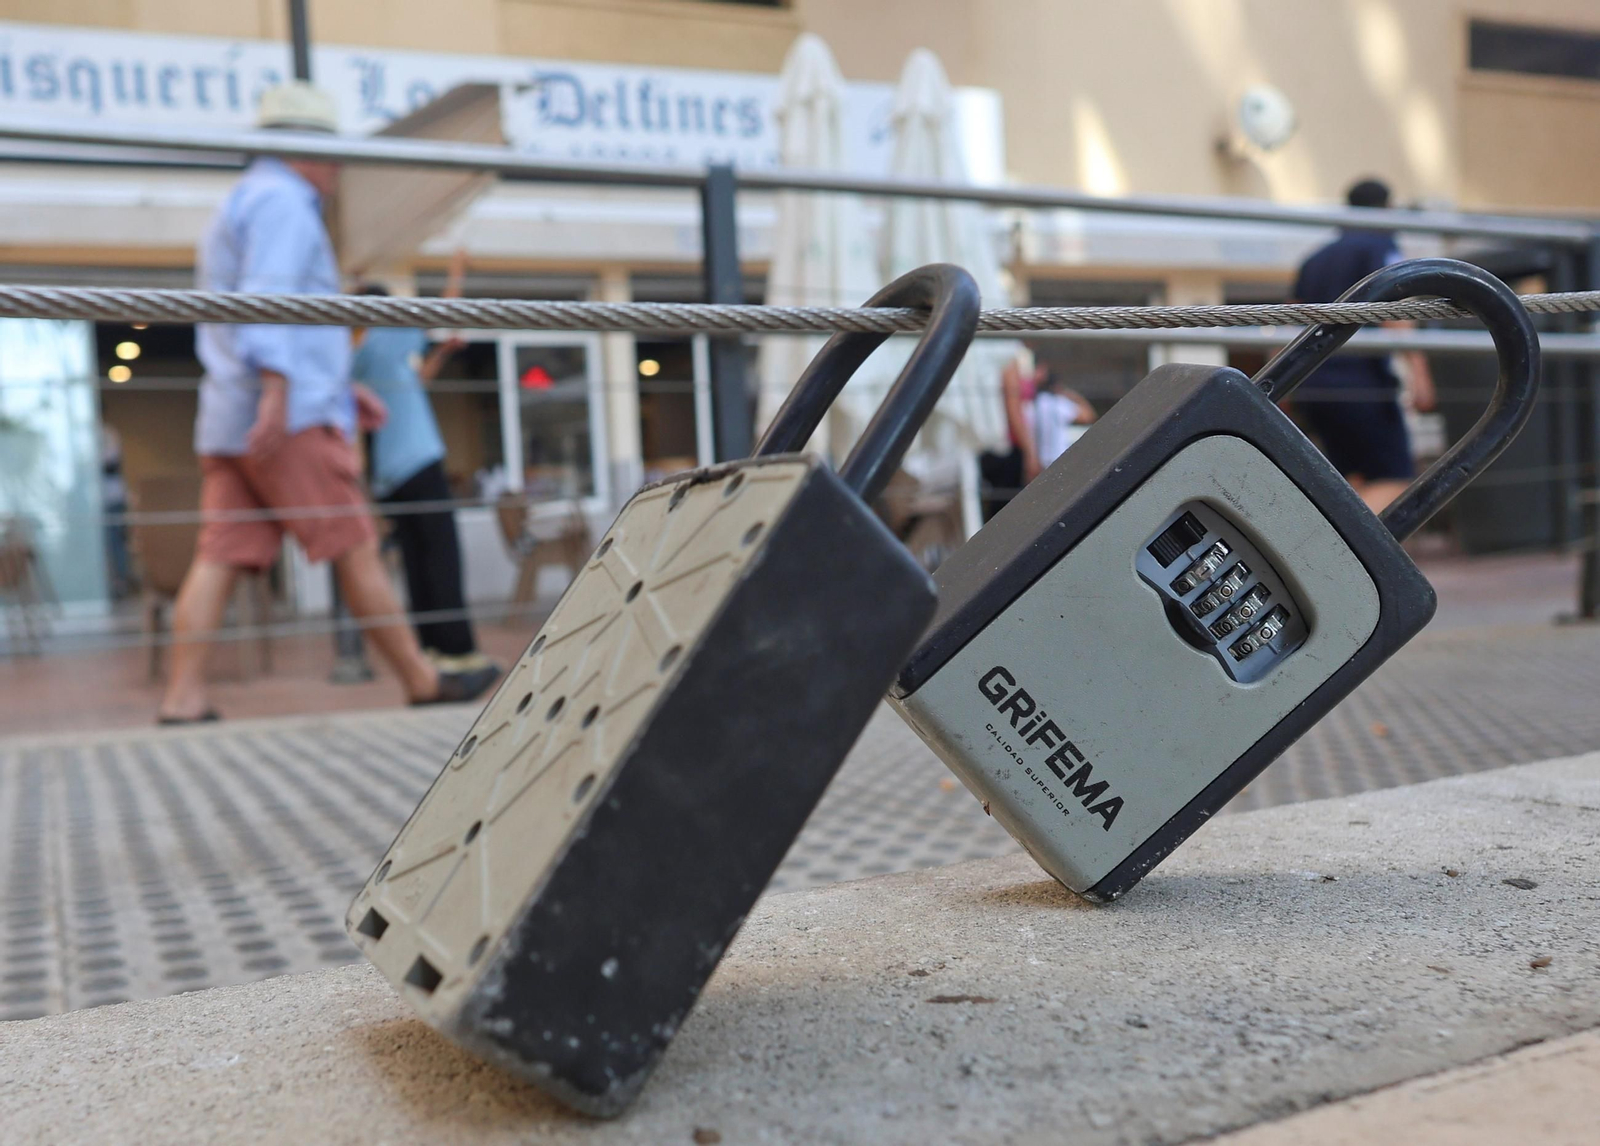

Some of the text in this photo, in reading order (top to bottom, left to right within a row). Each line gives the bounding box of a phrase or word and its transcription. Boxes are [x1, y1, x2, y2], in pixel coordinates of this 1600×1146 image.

[346, 57, 437, 122] Lo
[530, 66, 765, 138] Delfines
[985, 723, 1071, 817] CALIDAD SUPERIOR
